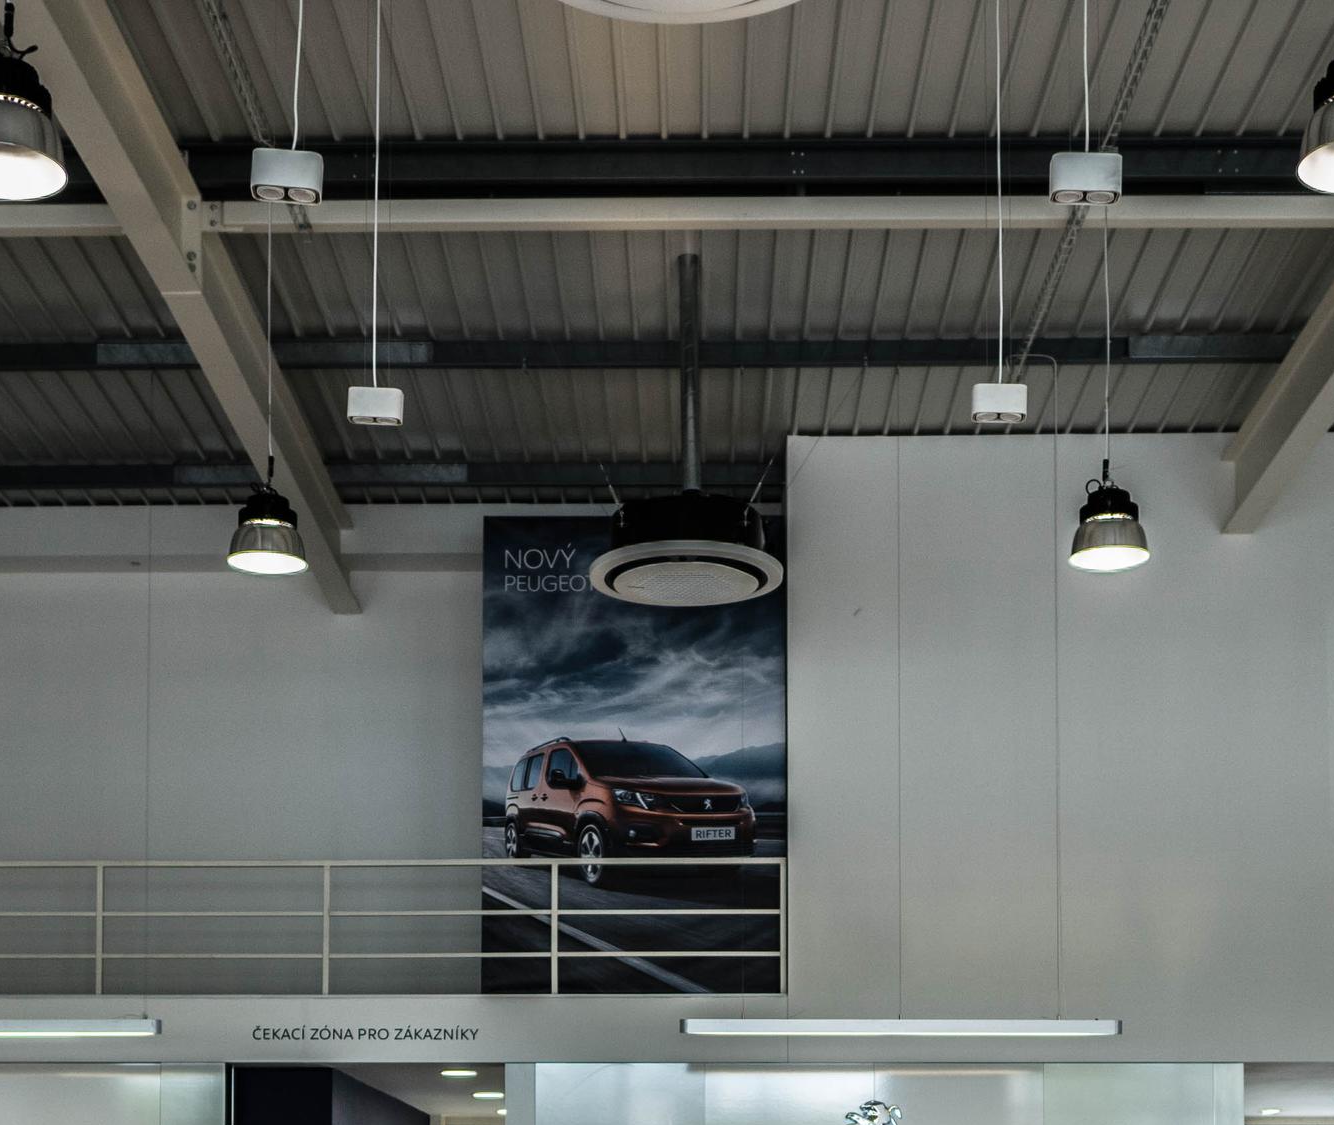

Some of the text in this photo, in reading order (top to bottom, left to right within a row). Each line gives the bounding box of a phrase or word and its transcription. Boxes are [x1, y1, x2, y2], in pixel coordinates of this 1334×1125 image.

[504, 543, 577, 569] NOVÝ
[695, 829, 732, 839] RIFTER
[252, 1025, 479, 1040] ČEKACÍ ZÓNA PRO ZÁKAZNÍKY
